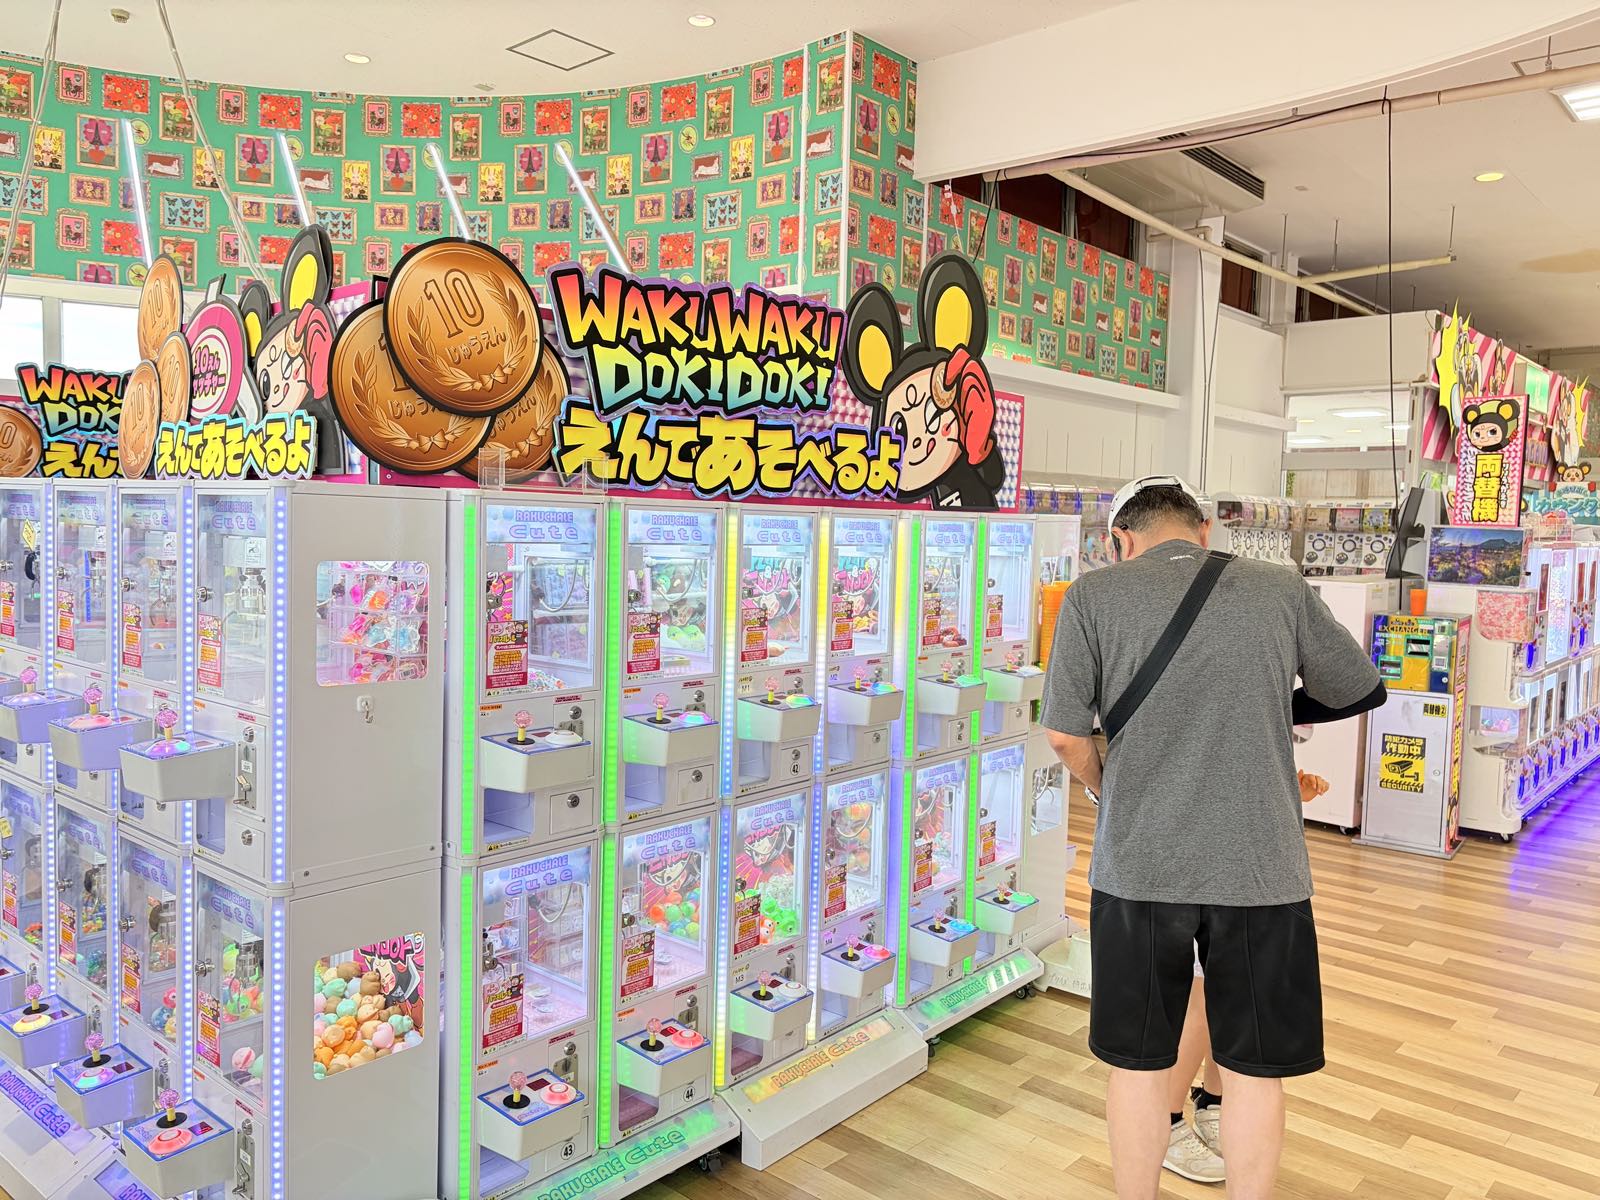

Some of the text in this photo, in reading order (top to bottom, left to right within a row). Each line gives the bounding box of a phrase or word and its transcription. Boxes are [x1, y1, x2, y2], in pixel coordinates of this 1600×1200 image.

[148, 278, 163, 328] 10
[423, 267, 486, 339] 10
[550, 271, 844, 362] WAKUWAKU
[445, 326, 507, 365] じゅうえん
[591, 343, 834, 414] DOKIDOKI
[157, 417, 311, 479] えんであそべるよ
[561, 406, 900, 492] えんであそべるよ
[1471, 453, 1504, 523] 両替機
[1536, 497, 1600, 514] カウンタ
[508, 524, 579, 540] Cute
[646, 527, 702, 541] Cute
[1385, 742, 1422, 756] 作動中
[791, 764, 799, 774] 42
[1381, 781, 1422, 792] SECURITY
[640, 836, 696, 860] Cute
[504, 868, 573, 896] Cute
[828, 1030, 871, 1058] Cute
[685, 1087, 694, 1100] 44
[33, 1103, 71, 1138] Cute
[563, 1144, 573, 1158] 43
[624, 1130, 686, 1165] Cute
